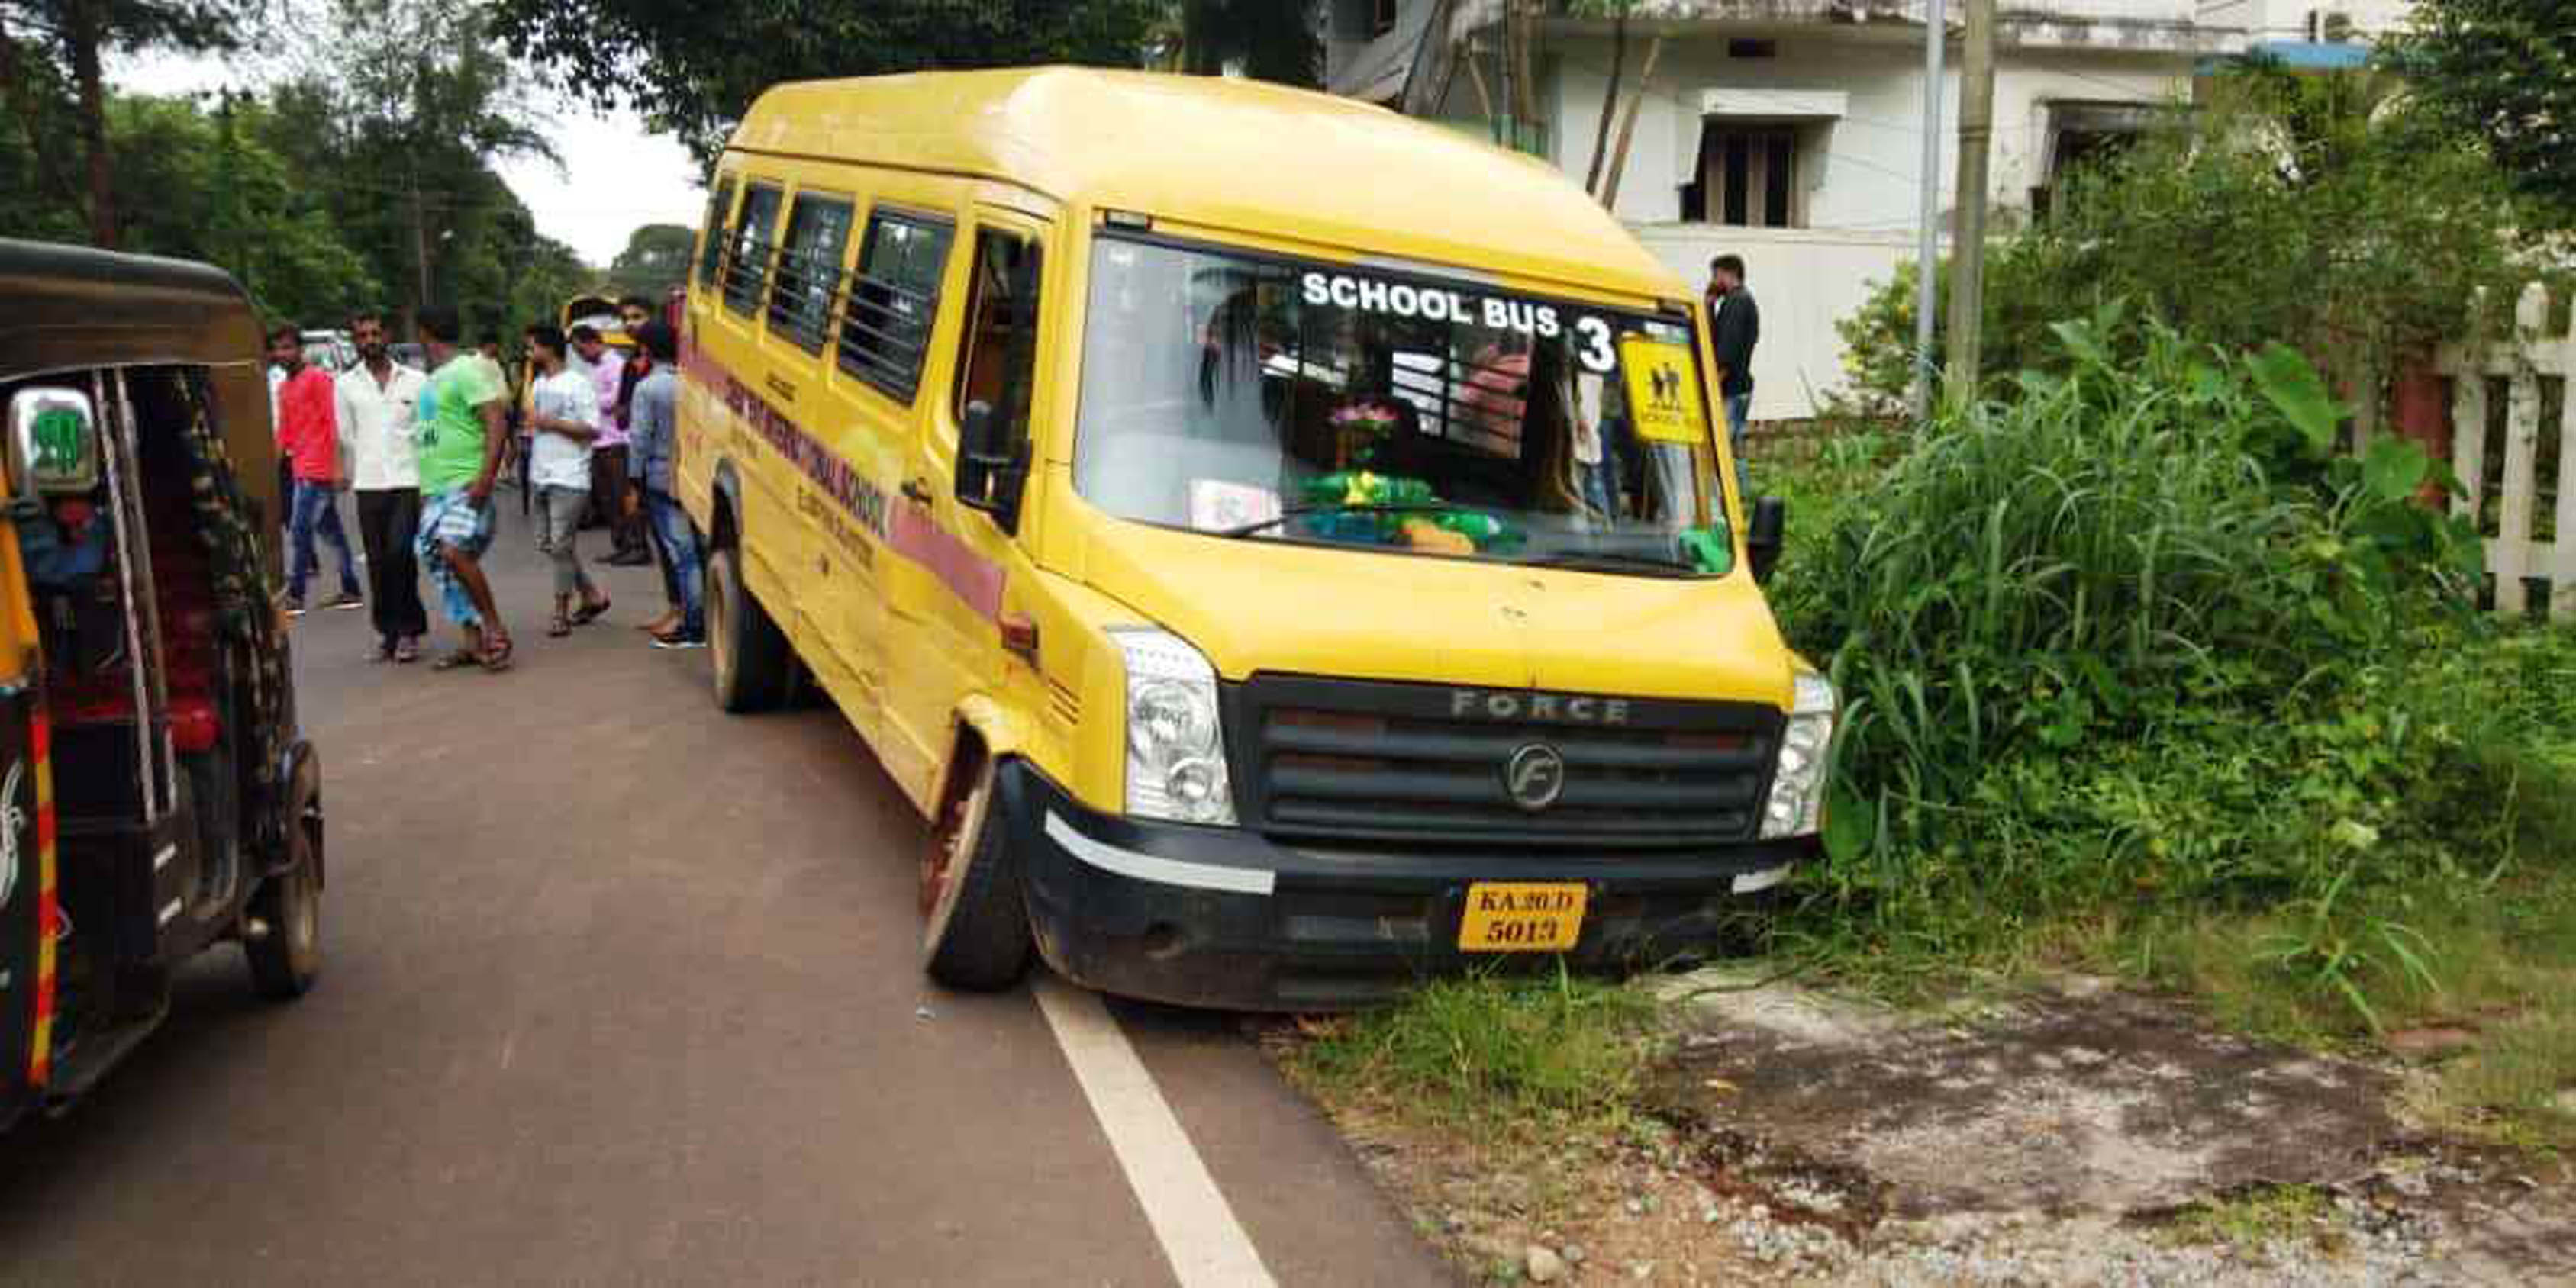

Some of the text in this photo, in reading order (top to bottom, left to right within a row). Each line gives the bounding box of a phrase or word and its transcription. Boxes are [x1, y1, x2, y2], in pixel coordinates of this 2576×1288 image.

[1302, 272, 1559, 337] SCHOOL BUS
[1577, 316, 1616, 372] 3
[1452, 691, 1629, 721] FORCE
[1487, 919, 1558, 943] 5013
